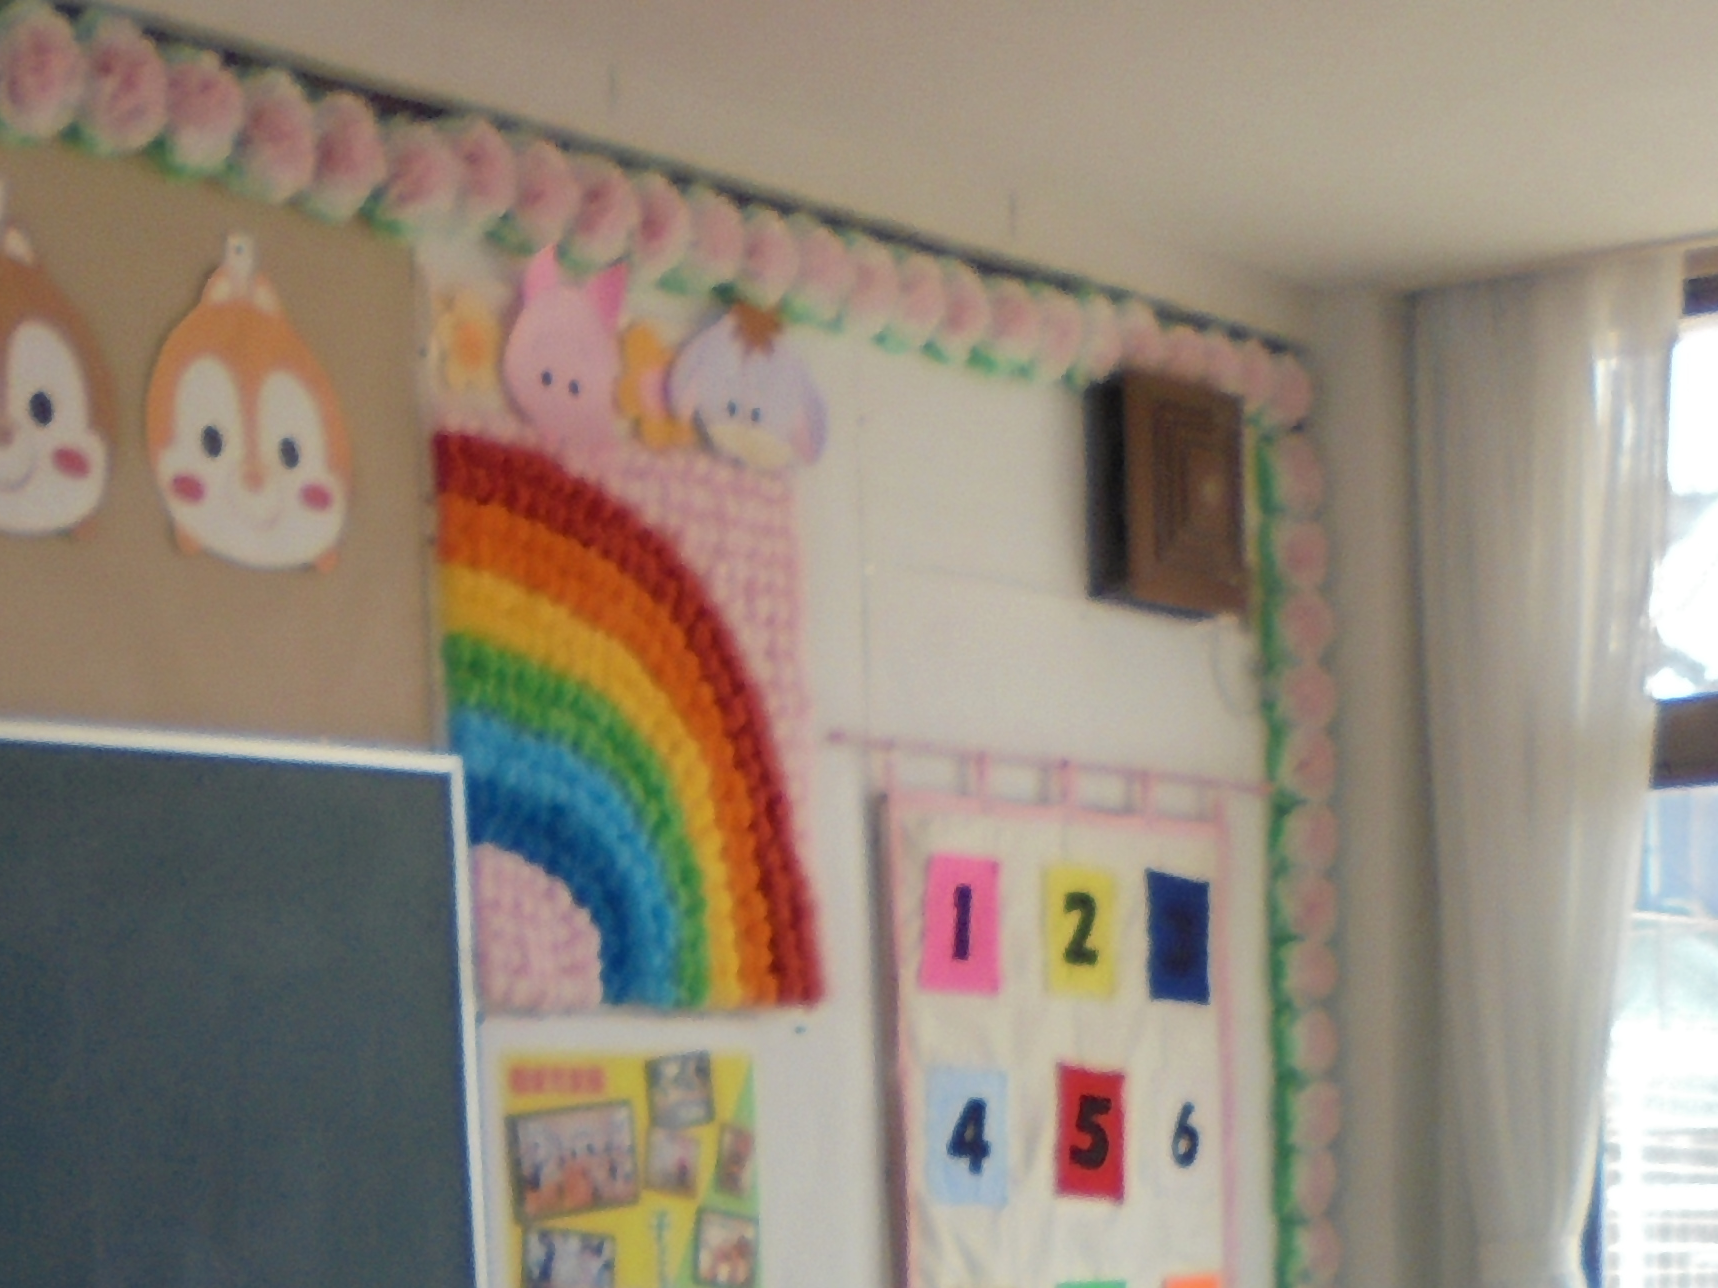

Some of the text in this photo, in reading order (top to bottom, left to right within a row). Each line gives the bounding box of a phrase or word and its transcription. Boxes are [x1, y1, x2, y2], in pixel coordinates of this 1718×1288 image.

[951, 884, 972, 961] 1
[1063, 892, 1099, 968] 2
[947, 1095, 1199, 1175] 4 5 6
